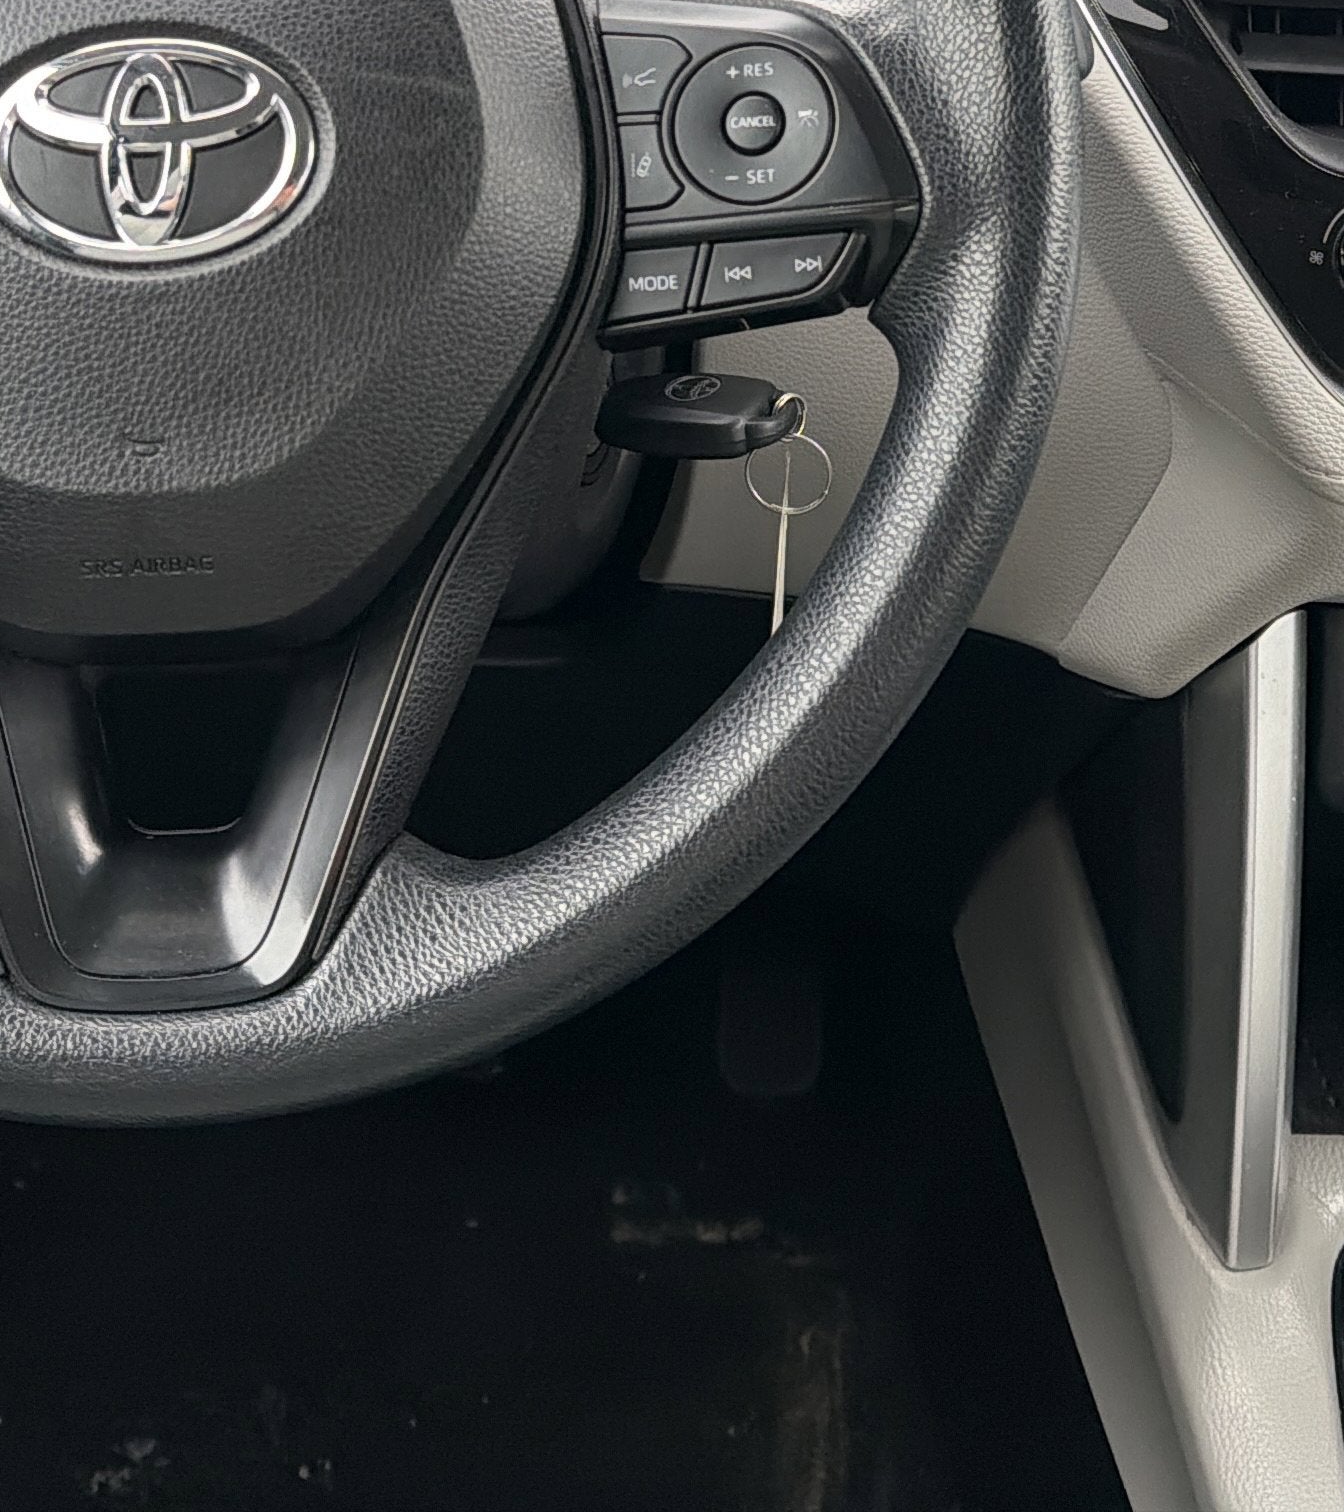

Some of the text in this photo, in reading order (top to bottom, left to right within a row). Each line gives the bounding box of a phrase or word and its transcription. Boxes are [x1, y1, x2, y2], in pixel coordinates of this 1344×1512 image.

[743, 62, 774, 77] RES
[729, 115, 776, 129] CANCEL
[746, 169, 775, 184] SET
[628, 274, 679, 292] MODE
[80, 555, 214, 578] SRS AIRBAG
